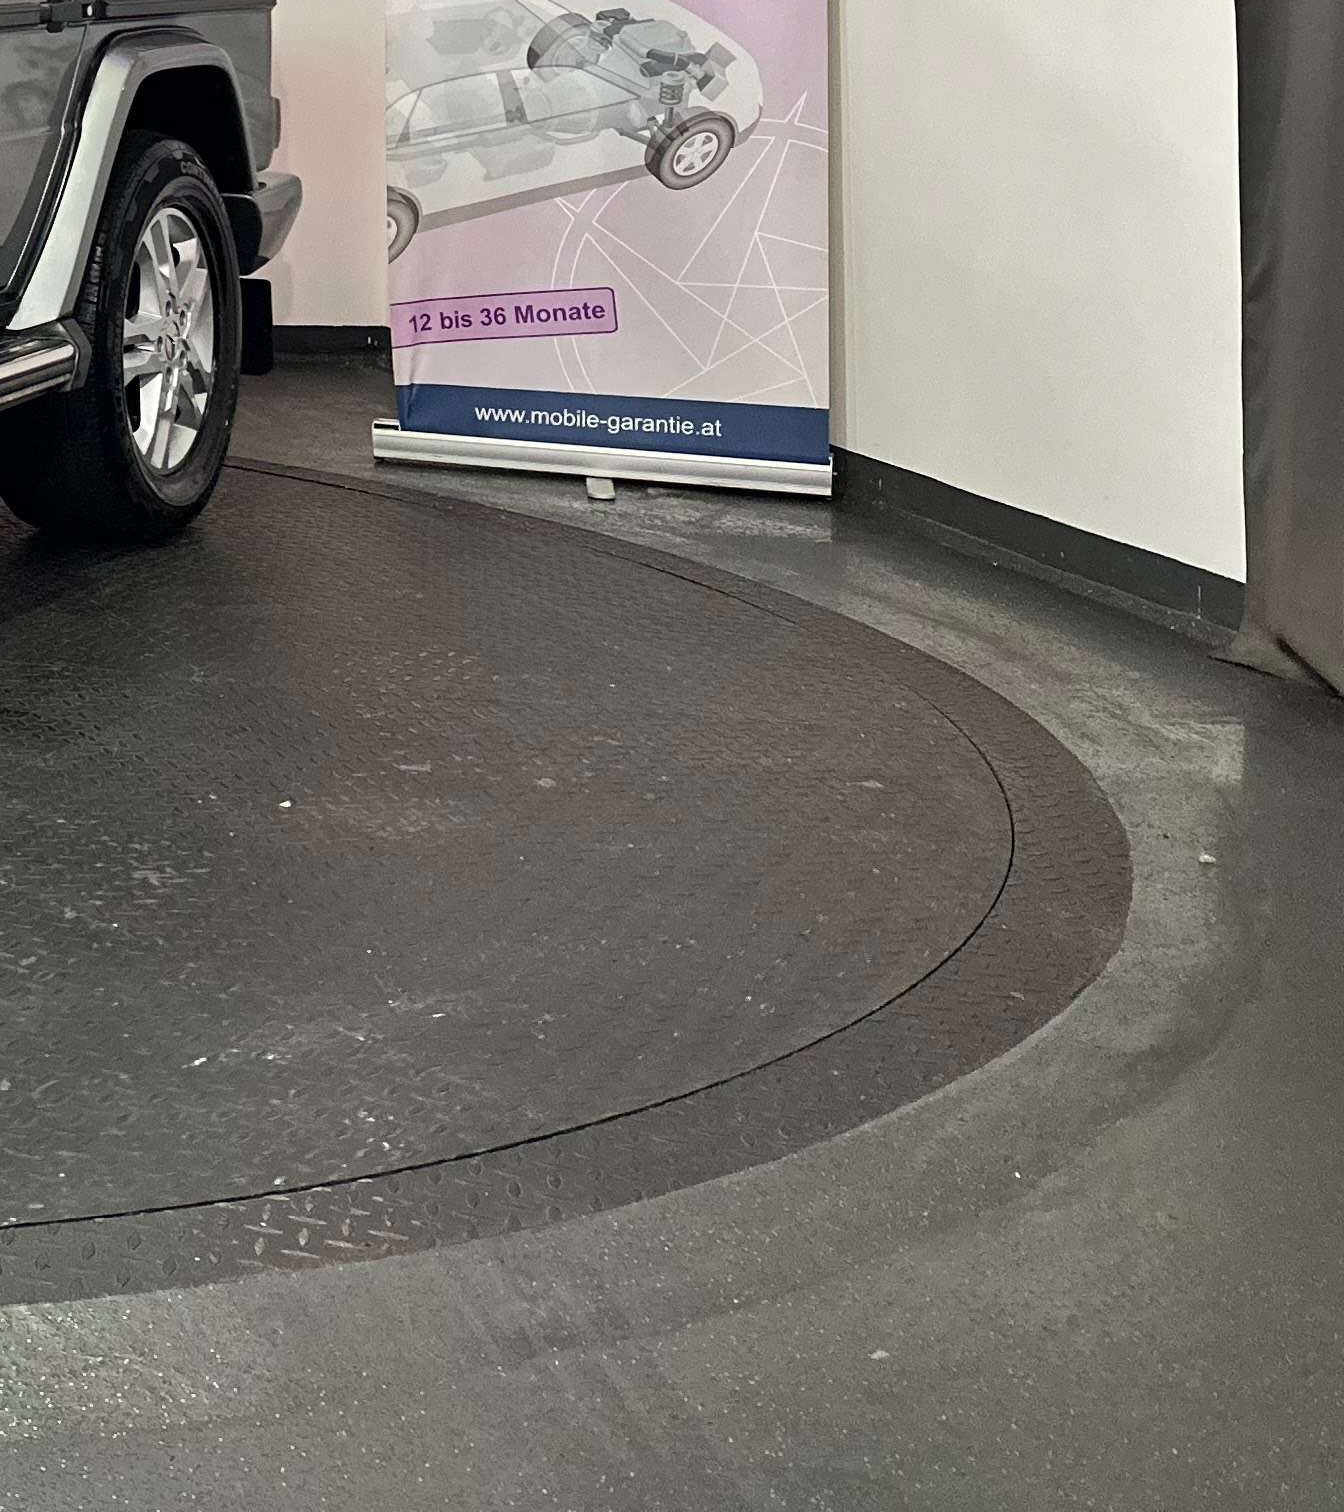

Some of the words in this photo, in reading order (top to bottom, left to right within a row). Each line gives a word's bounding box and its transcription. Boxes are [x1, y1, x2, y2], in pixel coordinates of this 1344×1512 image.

[408, 313, 433, 334] 12
[439, 309, 473, 331] bis
[479, 307, 507, 328] 36
[514, 301, 606, 325] Monate
[474, 406, 722, 437] www.mobile-garantie.at
